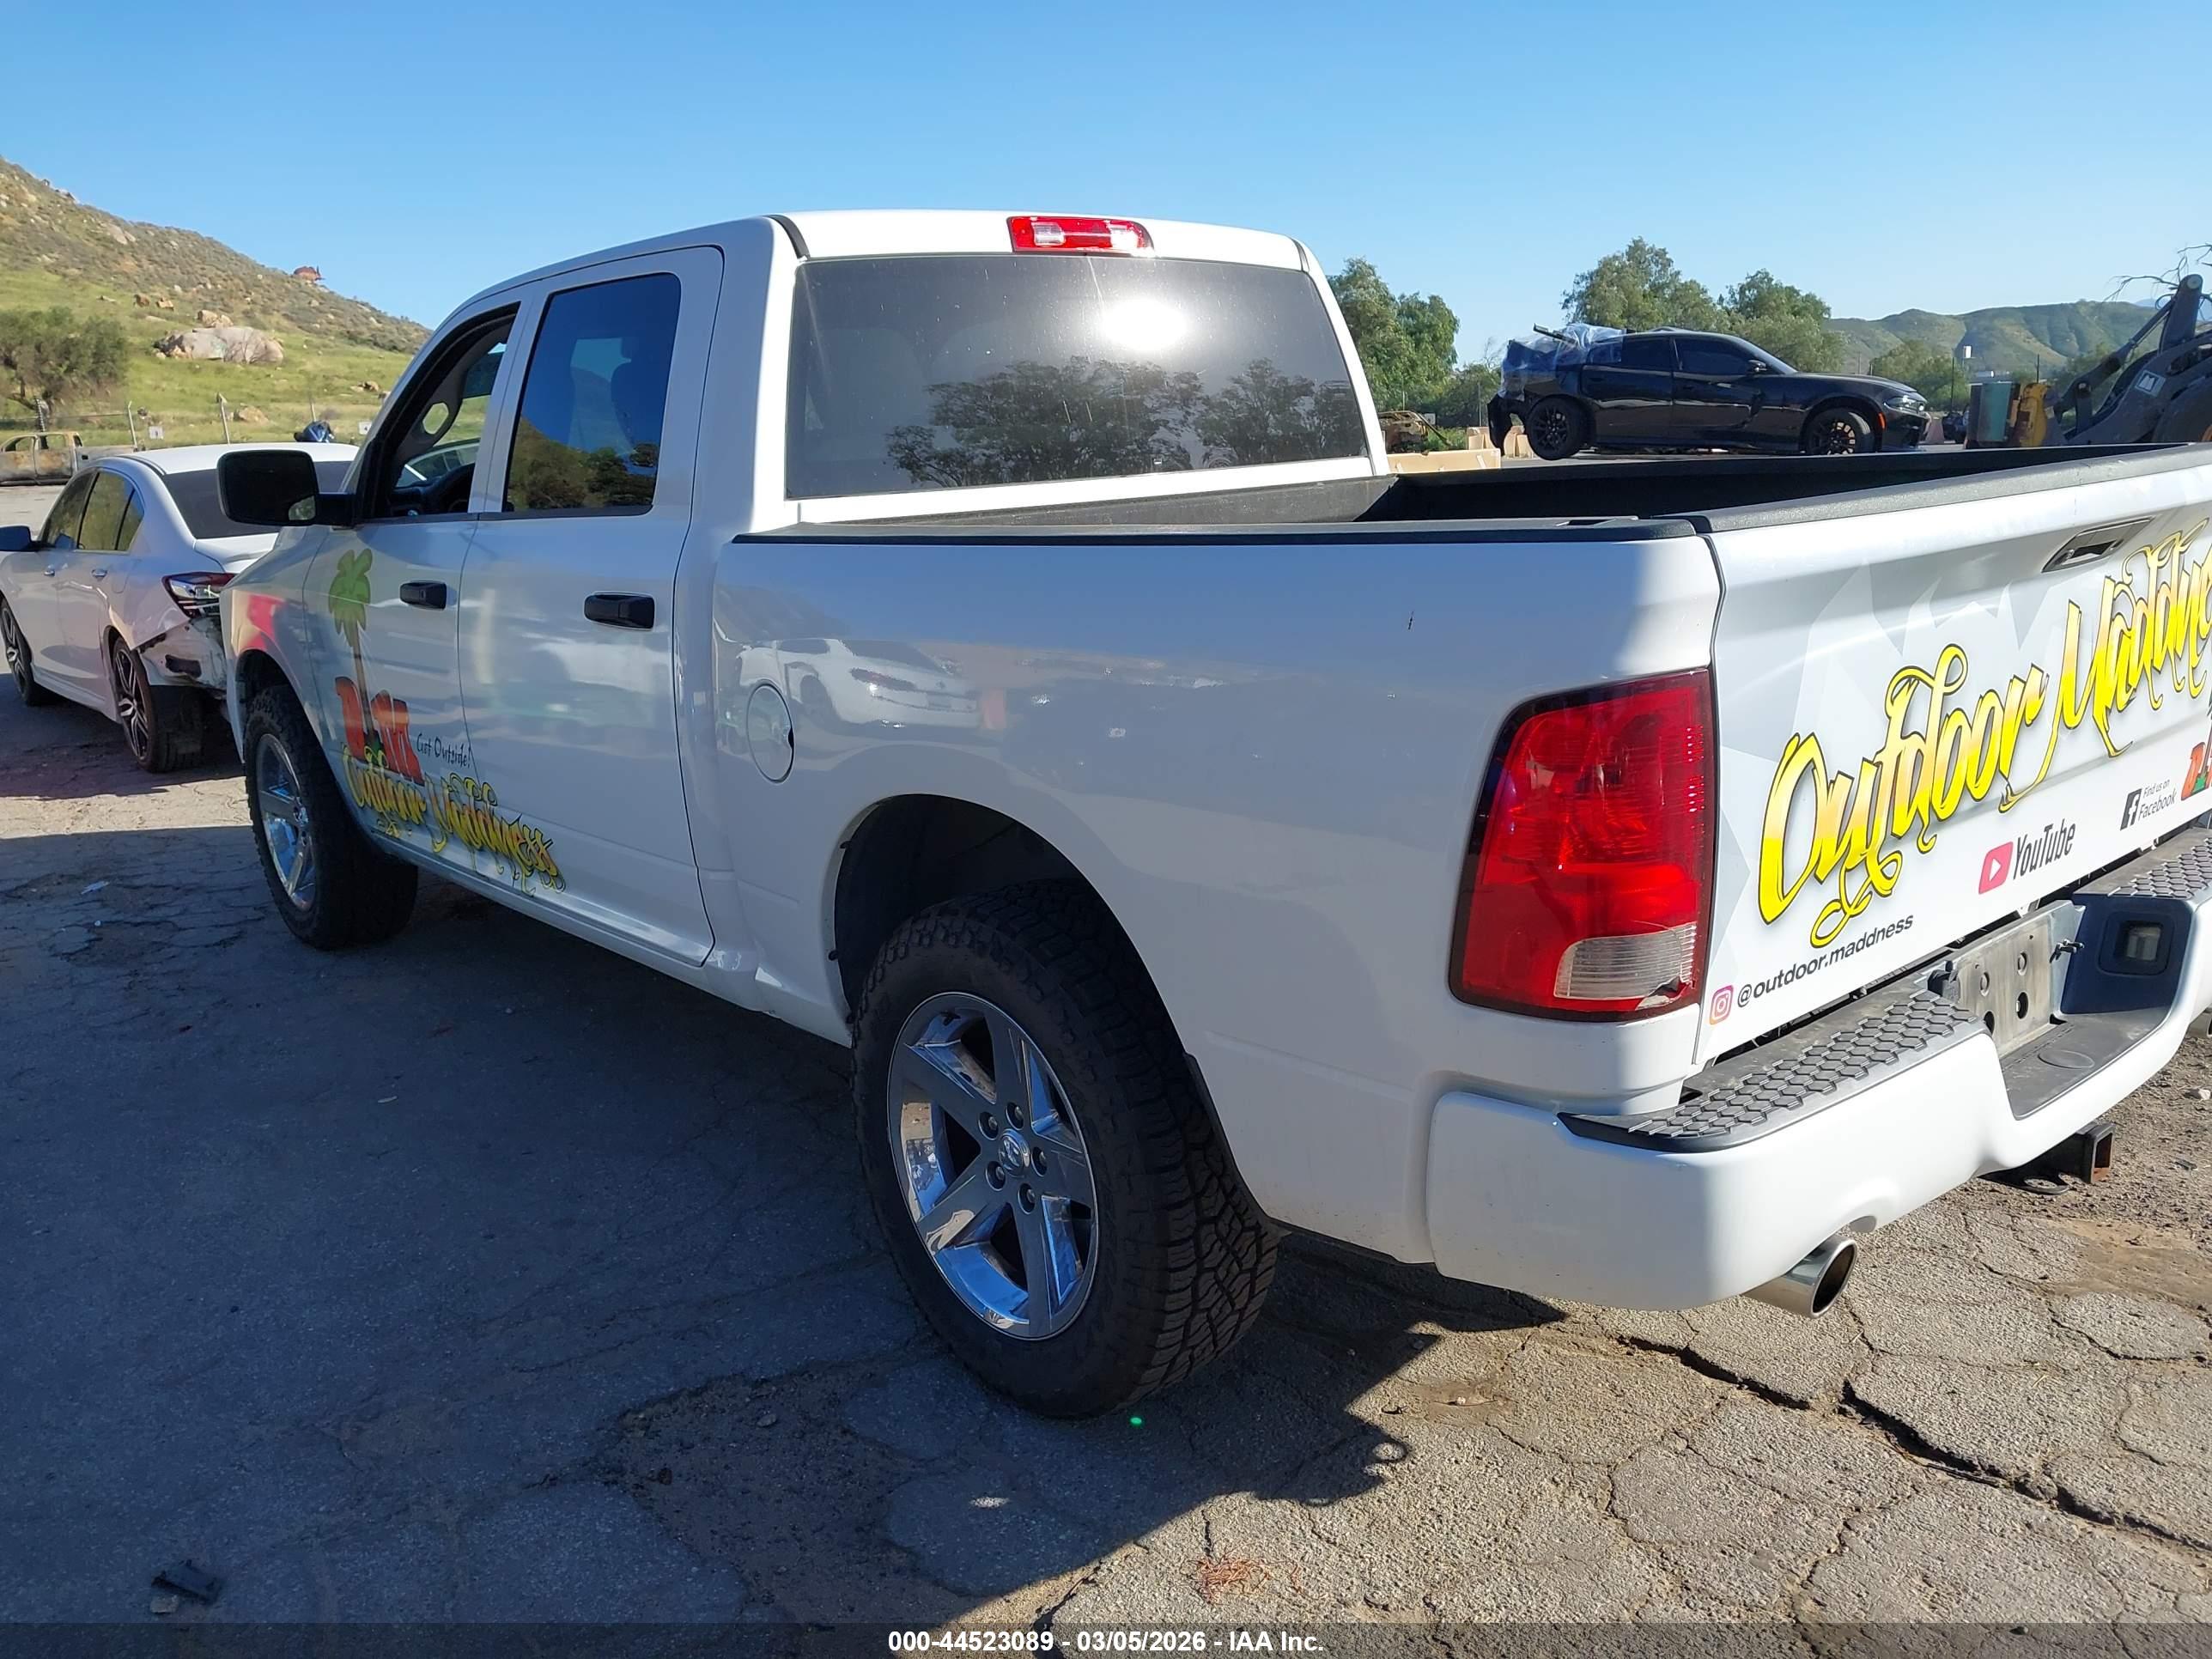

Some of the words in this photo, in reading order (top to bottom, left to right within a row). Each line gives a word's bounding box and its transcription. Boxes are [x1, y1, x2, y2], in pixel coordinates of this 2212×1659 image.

[416, 732, 432, 757] Get
[434, 736, 471, 769] Outside!
[1759, 643, 2050, 948] Outdoor
[2137, 787, 2178, 822] Facebook
[2142, 784, 2154, 799] Find
[2154, 781, 2162, 793] us
[2162, 779, 2171, 790] on
[2013, 817, 2076, 880] YouTube
[1737, 914, 1914, 1007] @outdoor.maddness
